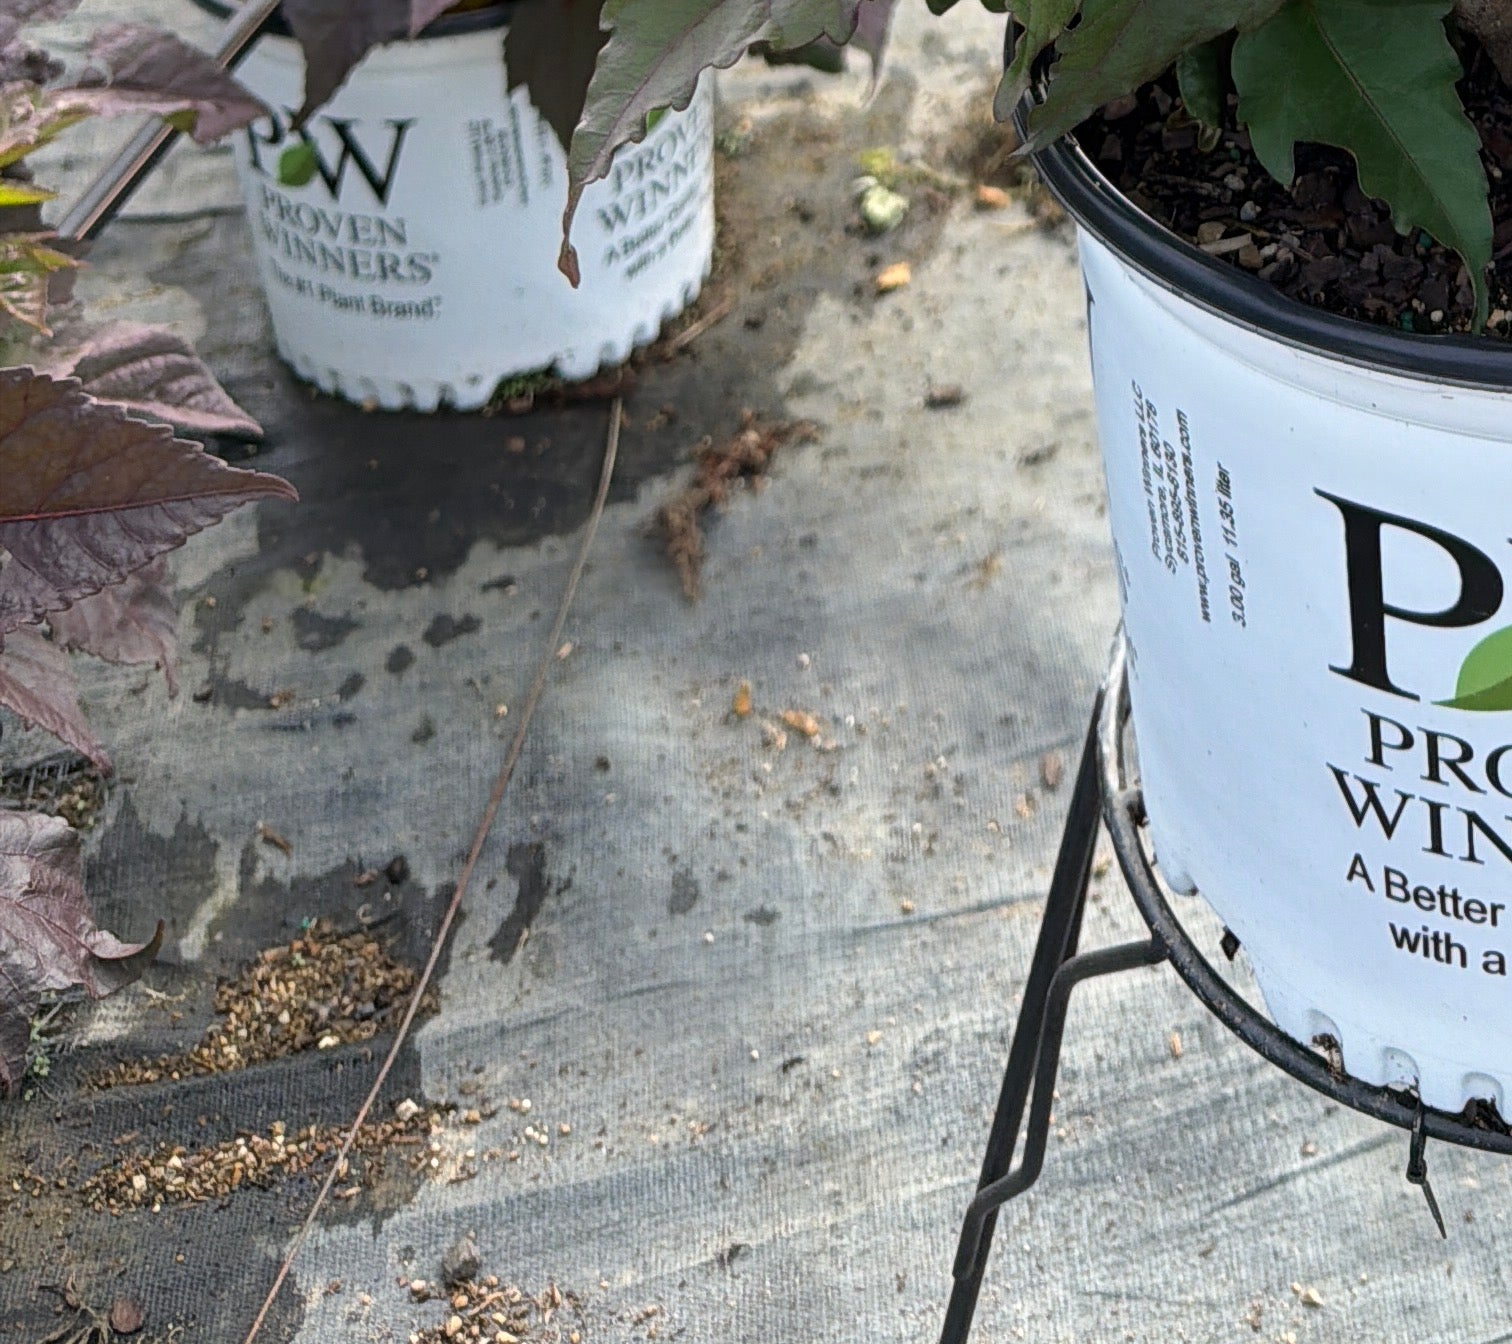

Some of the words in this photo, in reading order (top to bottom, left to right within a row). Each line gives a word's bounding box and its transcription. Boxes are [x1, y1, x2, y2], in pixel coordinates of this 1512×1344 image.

[261, 183, 408, 246] PROVEN
[1131, 378, 1146, 423] LLC
[1138, 423, 1154, 496] Winners
[1151, 463, 1165, 481] IL
[1215, 460, 1233, 500] liter
[1147, 499, 1163, 562] Proven
[1175, 408, 1211, 623] www.provenwinners.com
[1219, 497, 1238, 548] 11.35
[1224, 551, 1246, 589] gal
[1229, 584, 1247, 629] 3.00
[1345, 852, 1376, 894] A
[1383, 865, 1506, 928] Better
[1388, 921, 1468, 968] with
[1481, 950, 1507, 976] a
